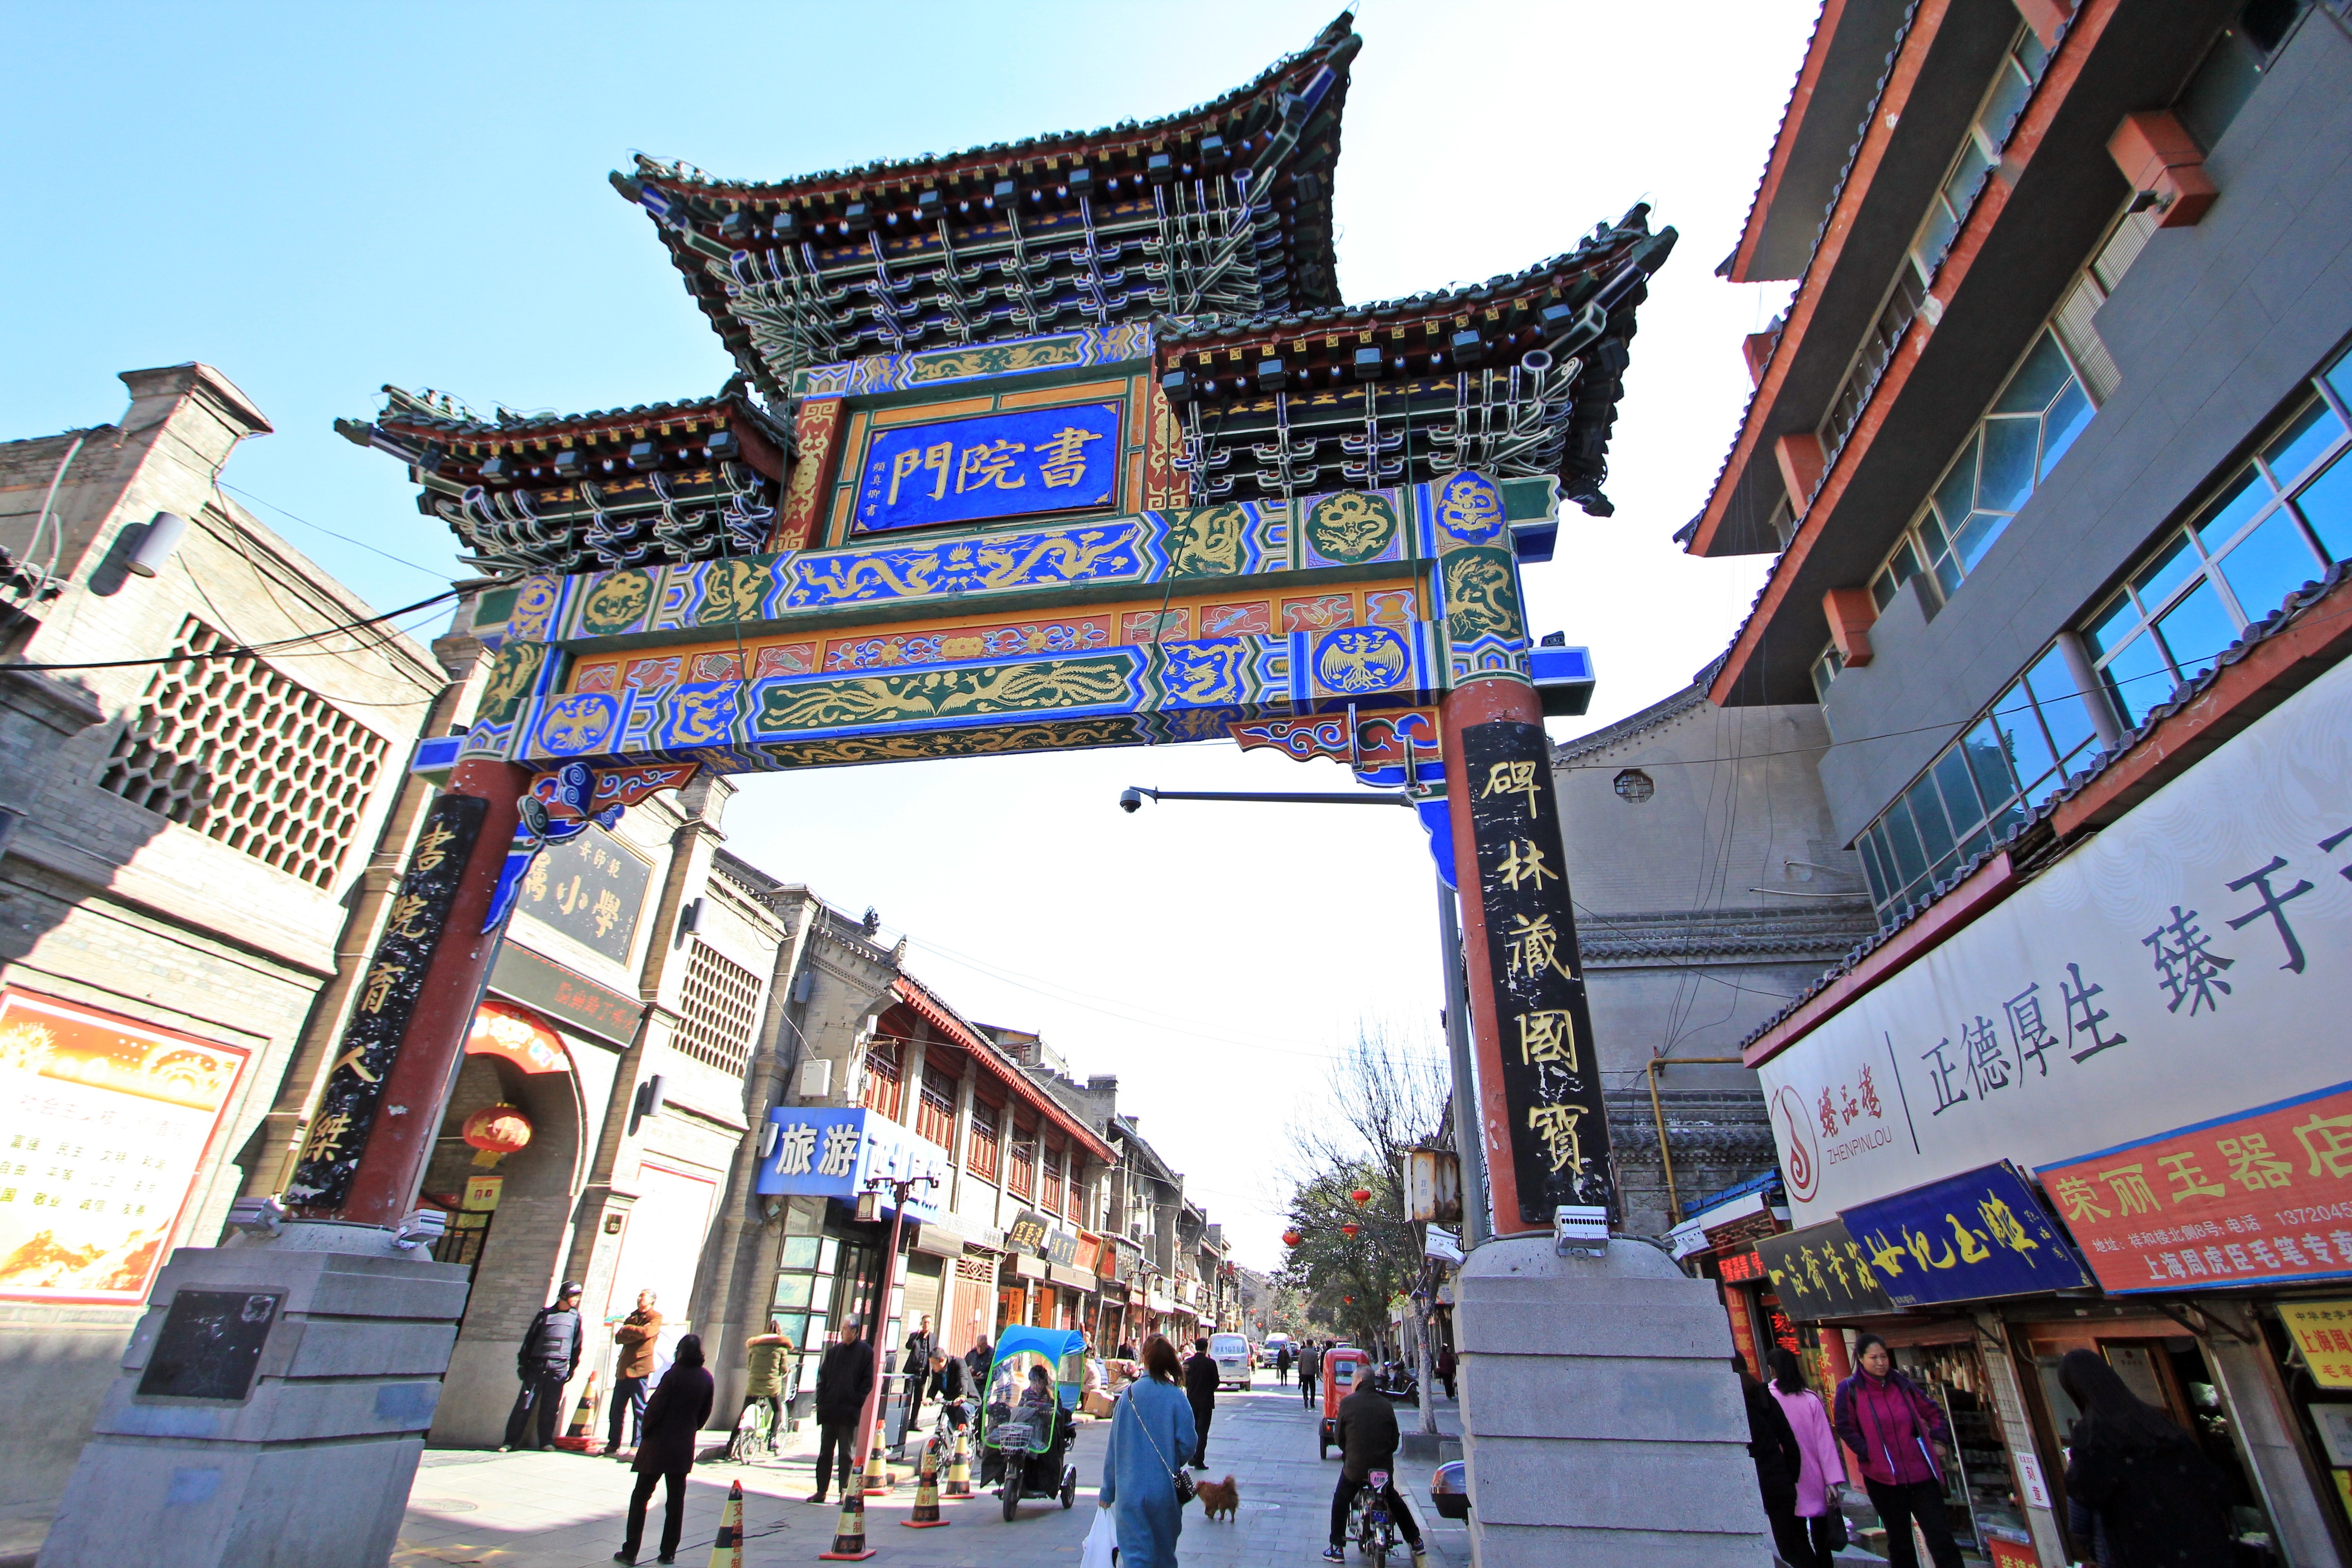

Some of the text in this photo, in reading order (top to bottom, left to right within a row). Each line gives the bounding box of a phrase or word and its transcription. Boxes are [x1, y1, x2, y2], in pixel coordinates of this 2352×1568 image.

[1921, 963, 2128, 1116] 正德厚生
[775, 1122, 860, 1177] 旅游
[1827, 1126, 1892, 1164] ZHENPINLOU
[2056, 1114, 2352, 1223] 荣丽玉器店
[0, 1186, 17, 1203] 国
[2299, 1329, 2352, 1353] 上海周
